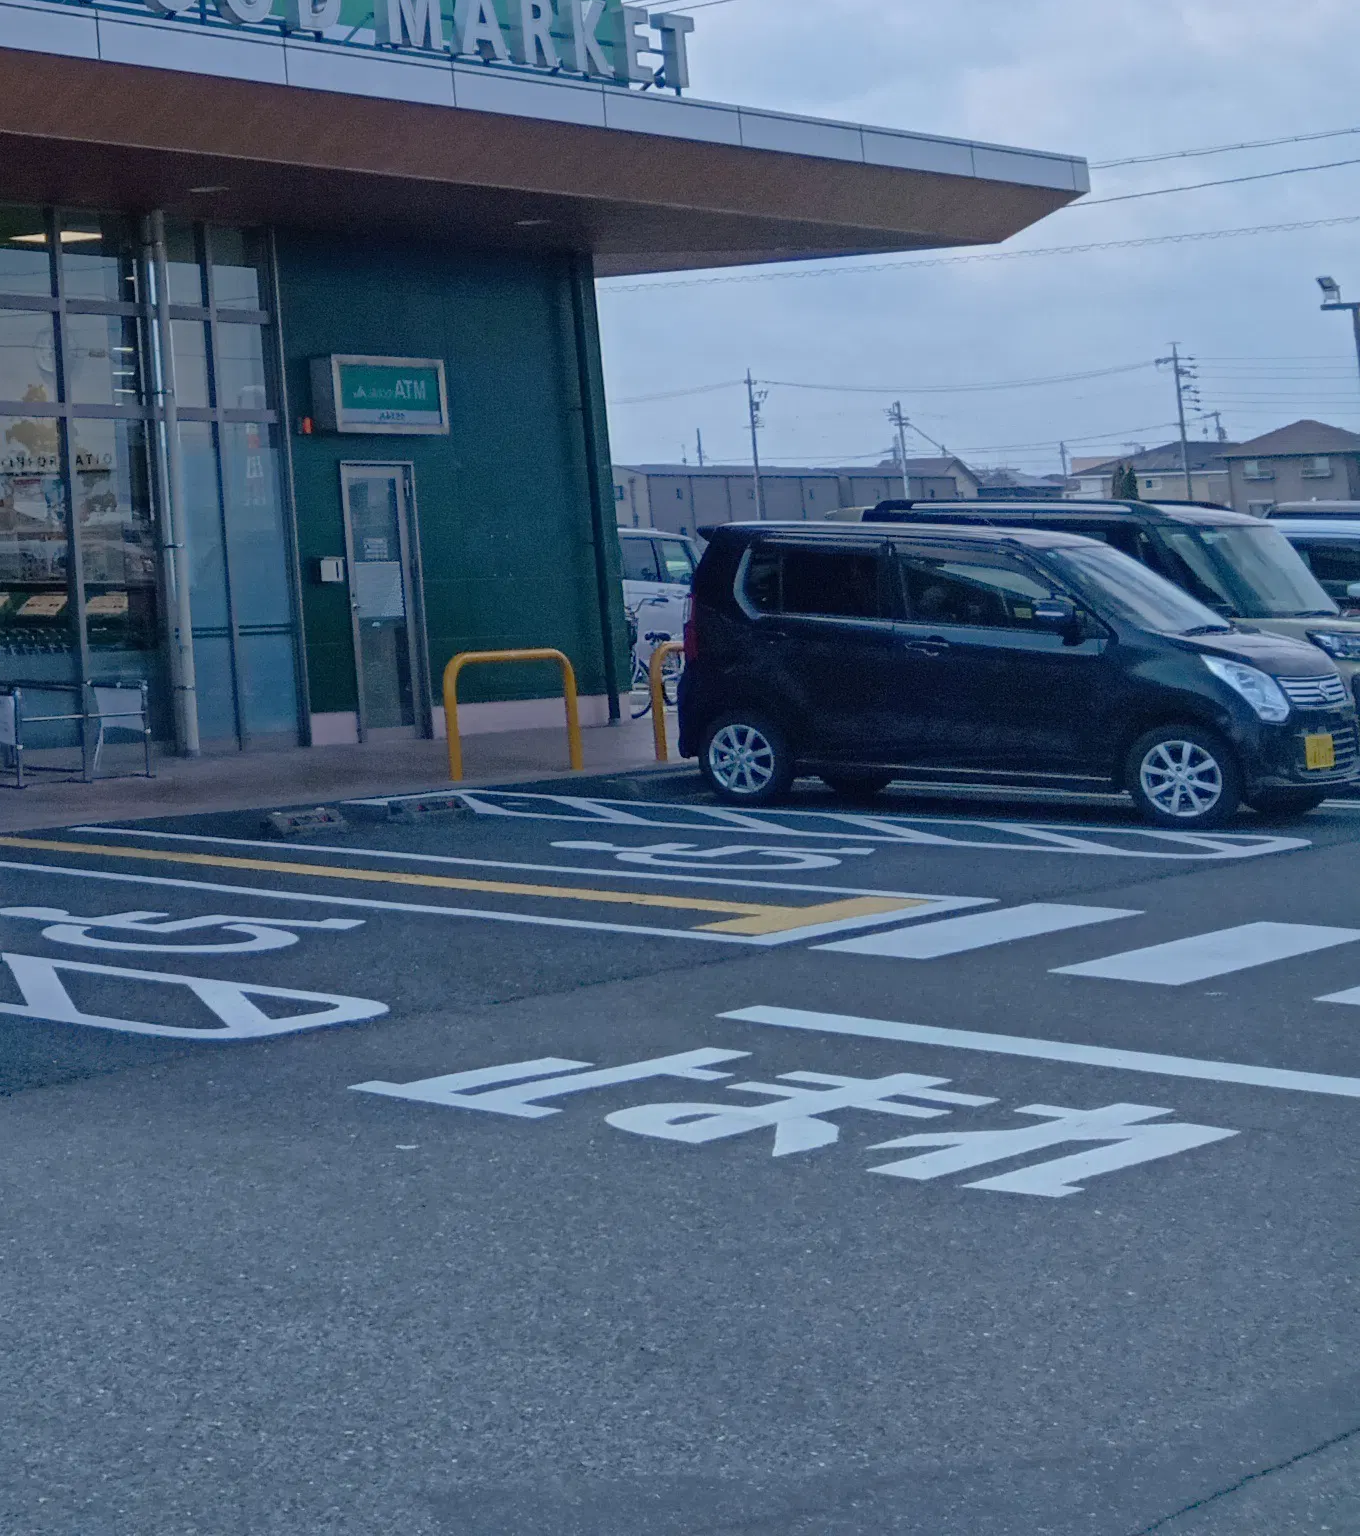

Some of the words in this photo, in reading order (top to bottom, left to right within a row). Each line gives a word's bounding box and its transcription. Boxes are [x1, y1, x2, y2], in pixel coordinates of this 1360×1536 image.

[396, 379, 426, 400] ATM
[348, 1047, 1241, 1197] 止まれ
